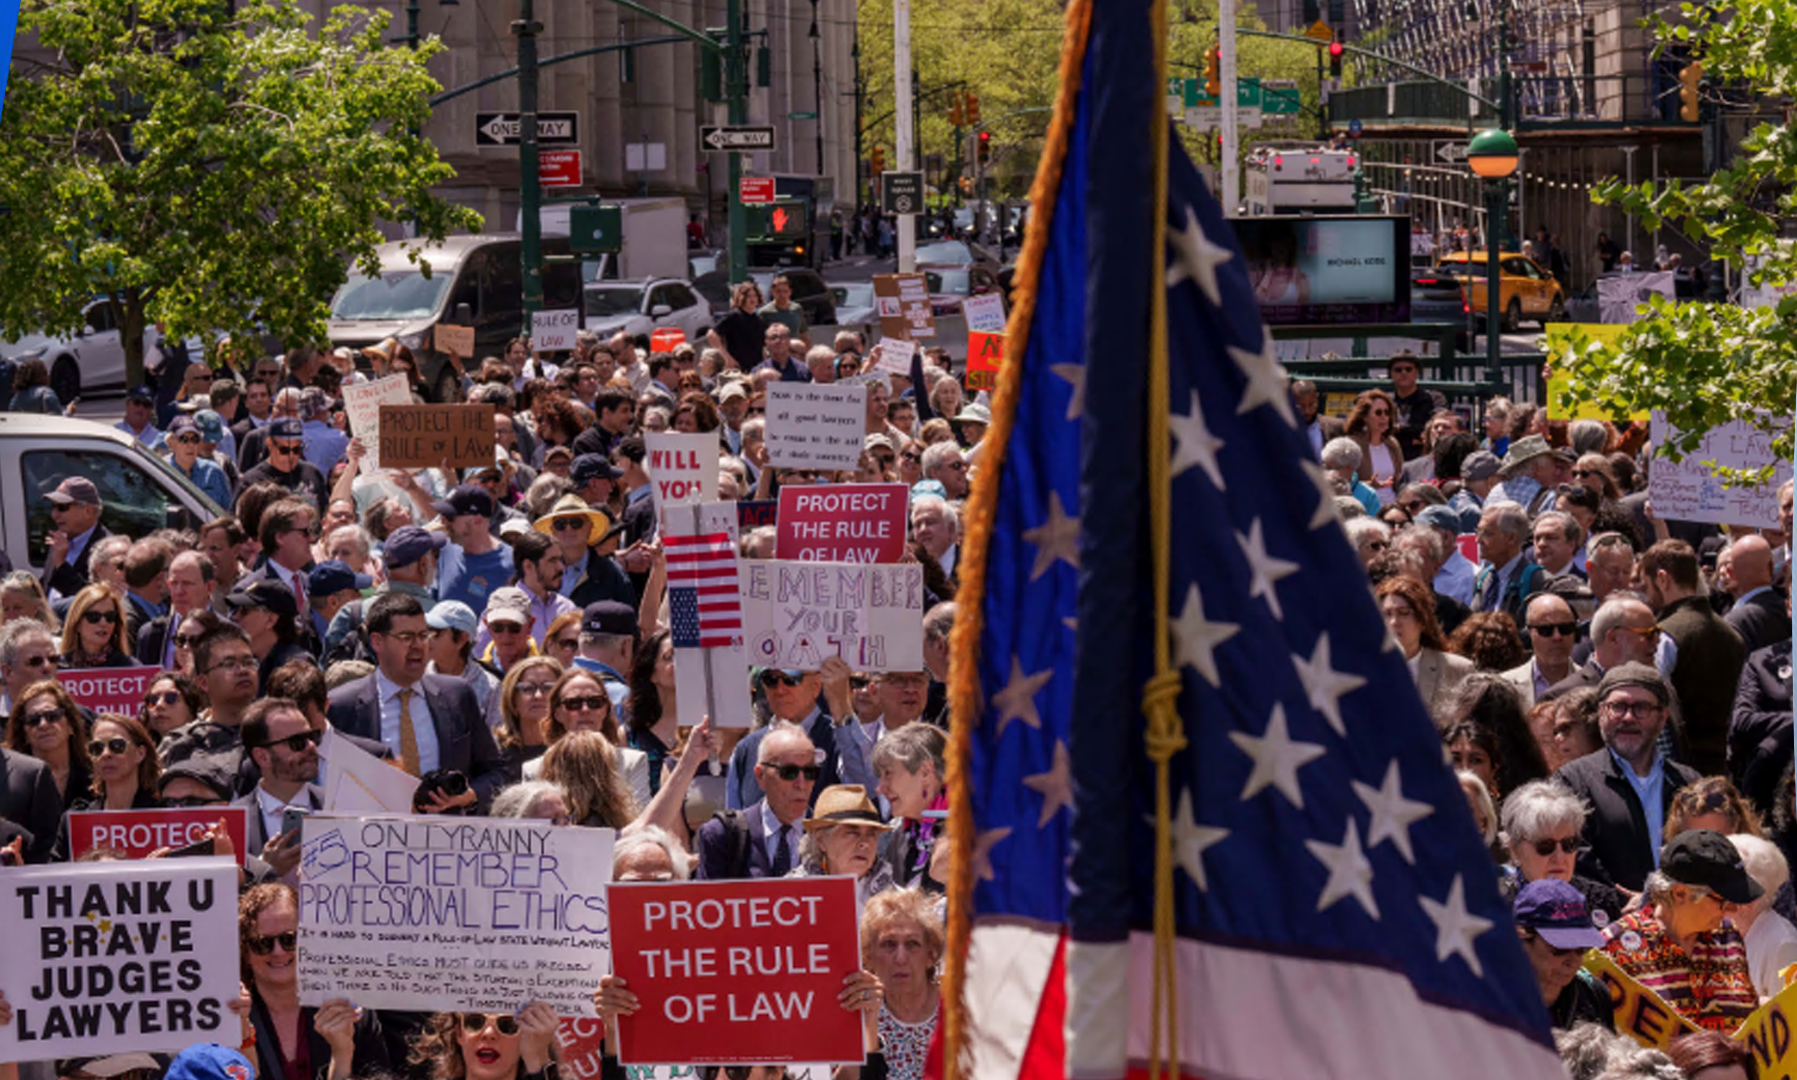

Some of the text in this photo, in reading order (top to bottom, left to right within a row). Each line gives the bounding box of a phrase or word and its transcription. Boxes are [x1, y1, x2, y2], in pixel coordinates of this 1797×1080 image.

[490, 122, 520, 136] ONE
[712, 133, 765, 144] ONE WAY
[533, 313, 576, 327] RULE OF
[541, 336, 564, 348] LAW
[806, 392, 821, 401] the
[382, 410, 488, 432] PROTECT THE
[382, 436, 426, 460] RULE
[453, 436, 495, 460] LAW
[650, 450, 701, 470] WILL
[658, 480, 702, 500] YOU
[796, 493, 890, 512] PROTECT
[791, 521, 891, 539] THE RULE
[798, 548, 880, 564] OF LAW
[742, 565, 921, 610] EMEMBER
[784, 607, 859, 636] YOUR
[752, 630, 887, 668] OATH
[302, 832, 351, 870] #5
[361, 823, 408, 848] ON
[352, 850, 568, 891] REMEMBER
[16, 879, 214, 919] THANK U
[300, 883, 608, 934] PROFESSIONAL ETHICS
[643, 896, 823, 931] PROTECT
[41, 920, 194, 959] BRAVE
[298, 947, 383, 967] PROFESSIONAL
[435, 957, 469, 970] MUST
[639, 944, 830, 978] THE RULE
[31, 959, 202, 1000] JUDGES
[16, 997, 221, 1041] LAWYERS
[663, 990, 815, 1023] OF LAW
